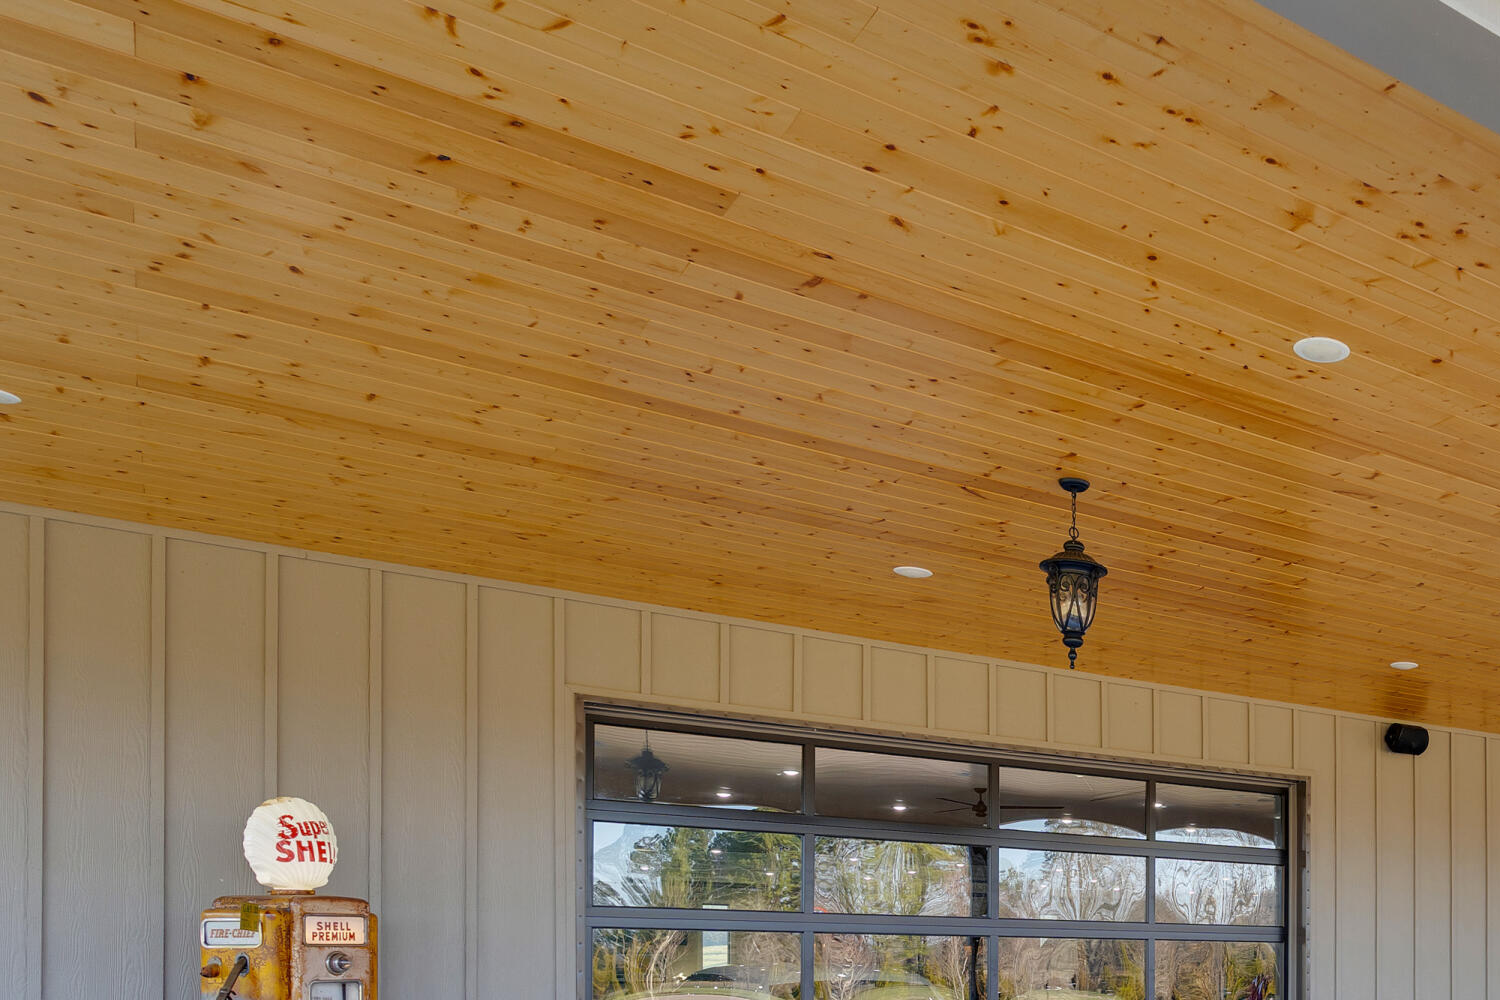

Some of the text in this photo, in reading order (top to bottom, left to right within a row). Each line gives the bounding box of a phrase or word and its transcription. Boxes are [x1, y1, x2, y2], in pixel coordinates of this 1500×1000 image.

[277, 814, 330, 839] Supe
[316, 921, 351, 931] SHELL
[311, 931, 356, 942] PREMIUM
